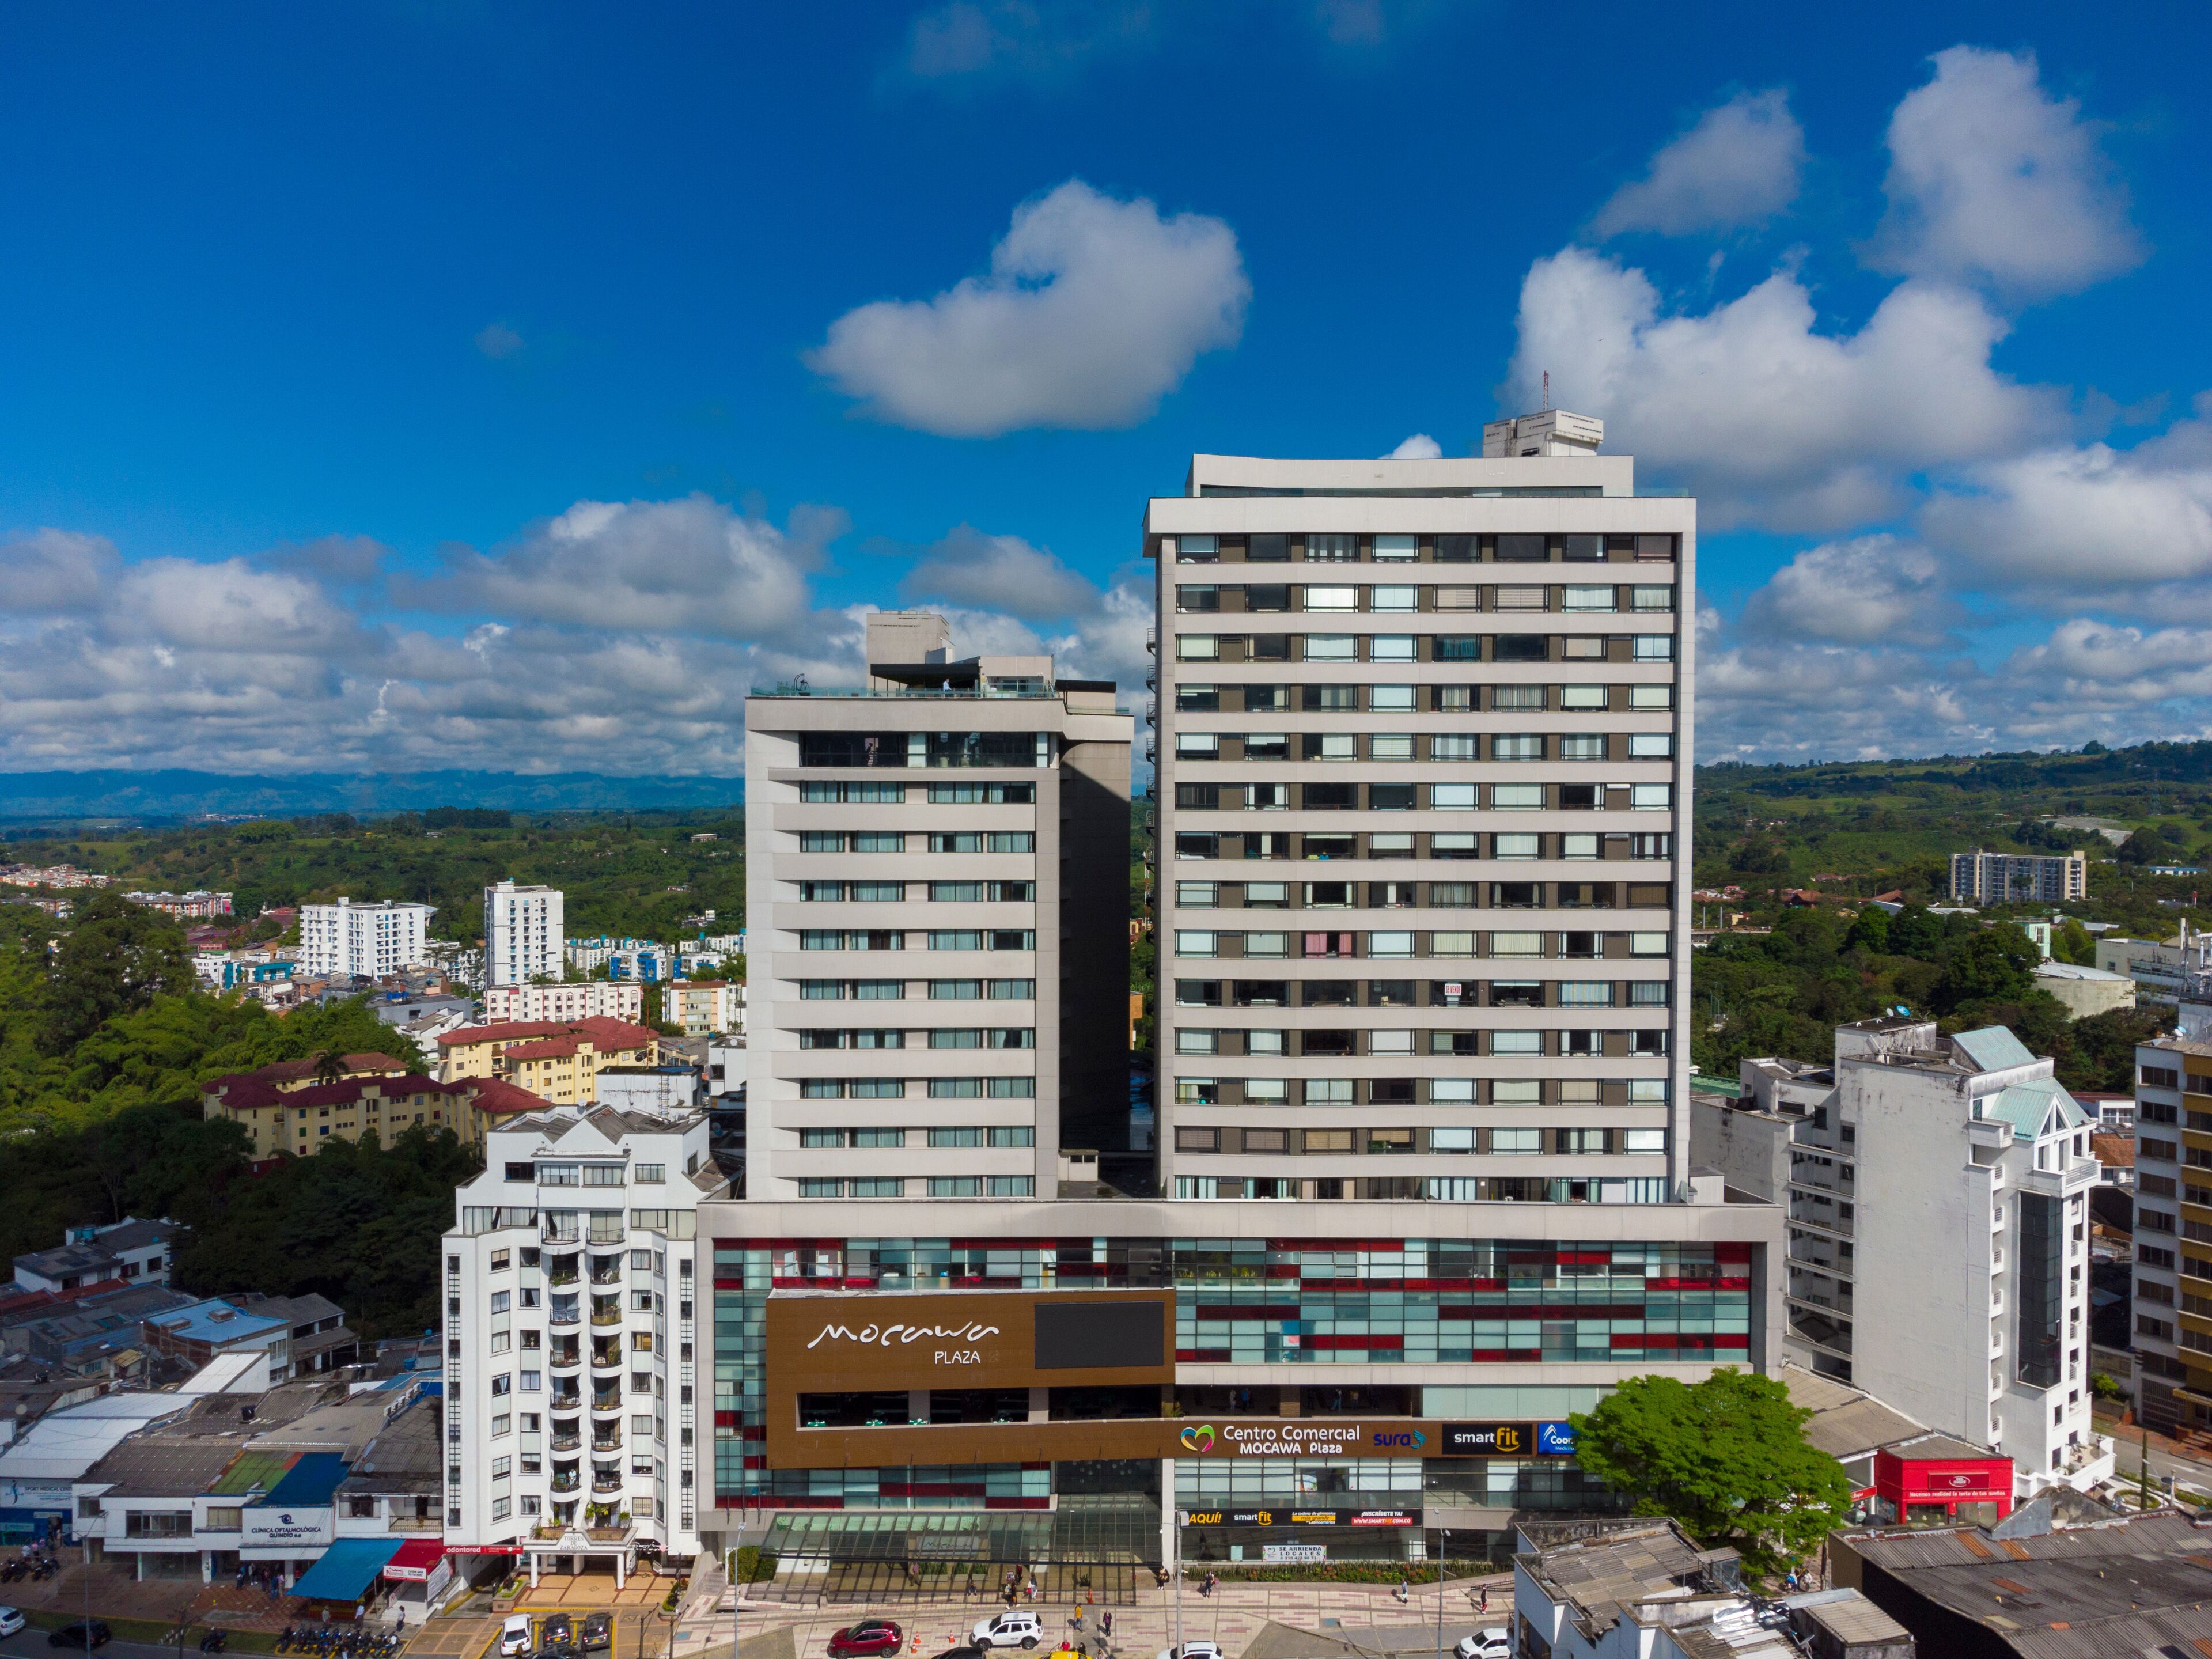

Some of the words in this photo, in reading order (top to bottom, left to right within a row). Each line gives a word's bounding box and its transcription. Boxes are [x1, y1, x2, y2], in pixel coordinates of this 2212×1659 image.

[935, 1351, 980, 1364] PLAZA
[1224, 1425, 1277, 1440] Centro
[1282, 1425, 1360, 1440] Comercial
[1373, 1433, 1411, 1446] sura
[1240, 1442, 1302, 1455] MOCAWA
[1310, 1442, 1343, 1454] Plaza
